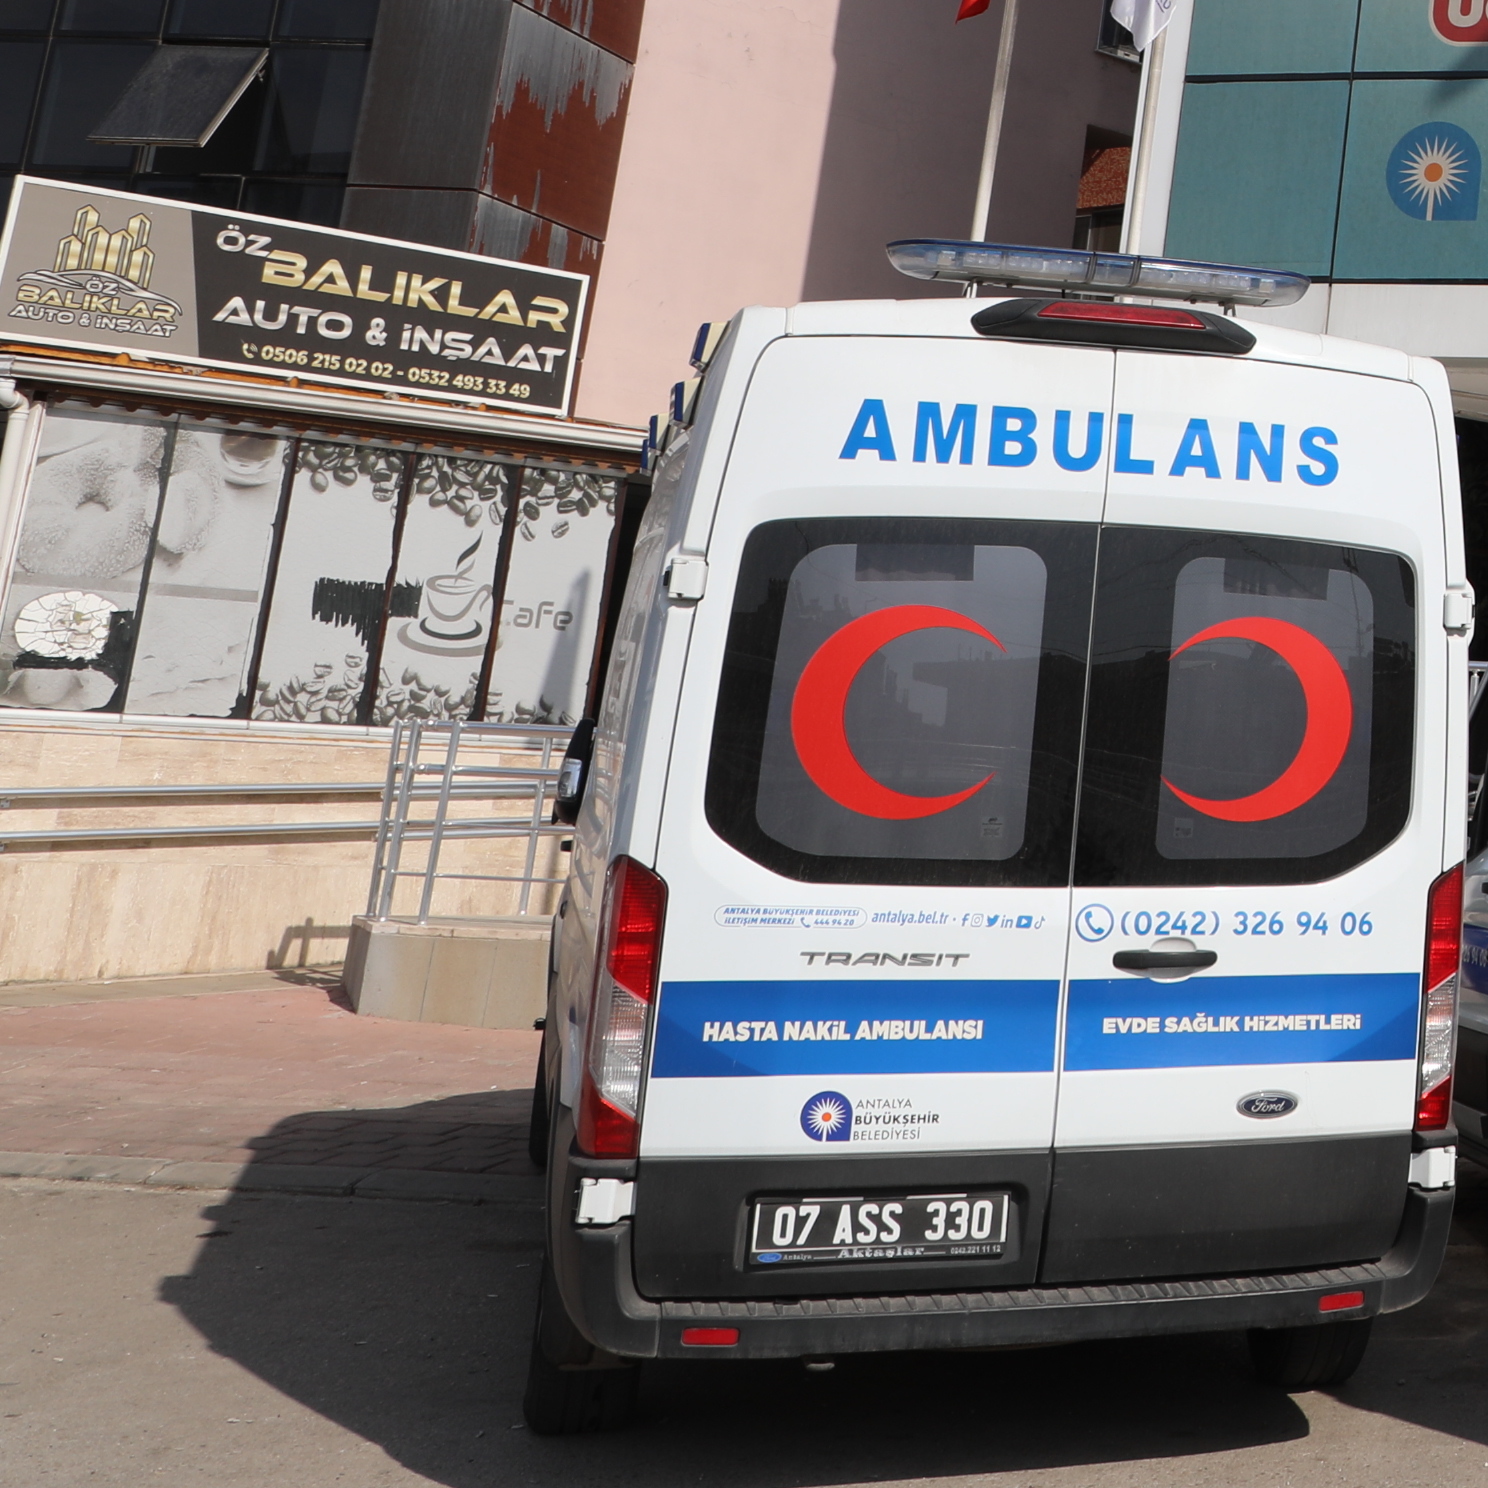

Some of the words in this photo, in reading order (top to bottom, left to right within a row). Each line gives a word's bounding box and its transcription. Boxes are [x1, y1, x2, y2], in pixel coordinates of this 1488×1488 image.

[216, 223, 272, 258] ÖZ
[85, 276, 120, 296] ÖZ
[261, 248, 570, 333] BALIKLAR
[8, 304, 75, 325] AUTO
[78, 312, 91, 327] &
[16, 284, 176, 323] BALIKLAR
[212, 295, 353, 340] AUTO
[364, 316, 389, 347] &
[261, 344, 309, 366] 0506
[312, 352, 341, 371] 215
[344, 356, 368, 376] 02
[371, 360, 393, 379] 02
[407, 367, 450, 388] 0532
[452, 374, 484, 393] 493
[487, 378, 507, 396] 33
[509, 382, 531, 400] 49
[838, 397, 1341, 488] AMBULANS
[871, 909, 950, 926] antalya.bel.tr
[1119, 910, 1220, 937] (0242)
[1232, 910, 1285, 937] 326
[1299, 911, 1329, 937] 94
[1339, 912, 1374, 937] 06
[800, 951, 971, 968] TRANSIT
[702, 1020, 780, 1044] HASTA
[783, 1019, 852, 1042] NAKİL
[854, 1018, 985, 1041] AMBULANSI
[1102, 1016, 1160, 1035] EVDE
[1163, 1012, 1241, 1034] SAĞLIK
[1243, 1014, 1362, 1032] HİZMETLERİ
[855, 1097, 913, 1111] ANTALYA
[854, 1109, 941, 1128] BÜYÜKŞEHİR
[852, 1126, 921, 1142] BELEDİYESİ
[772, 1204, 821, 1247] 07
[832, 1203, 903, 1245] ASS
[924, 1199, 994, 1241] 330
